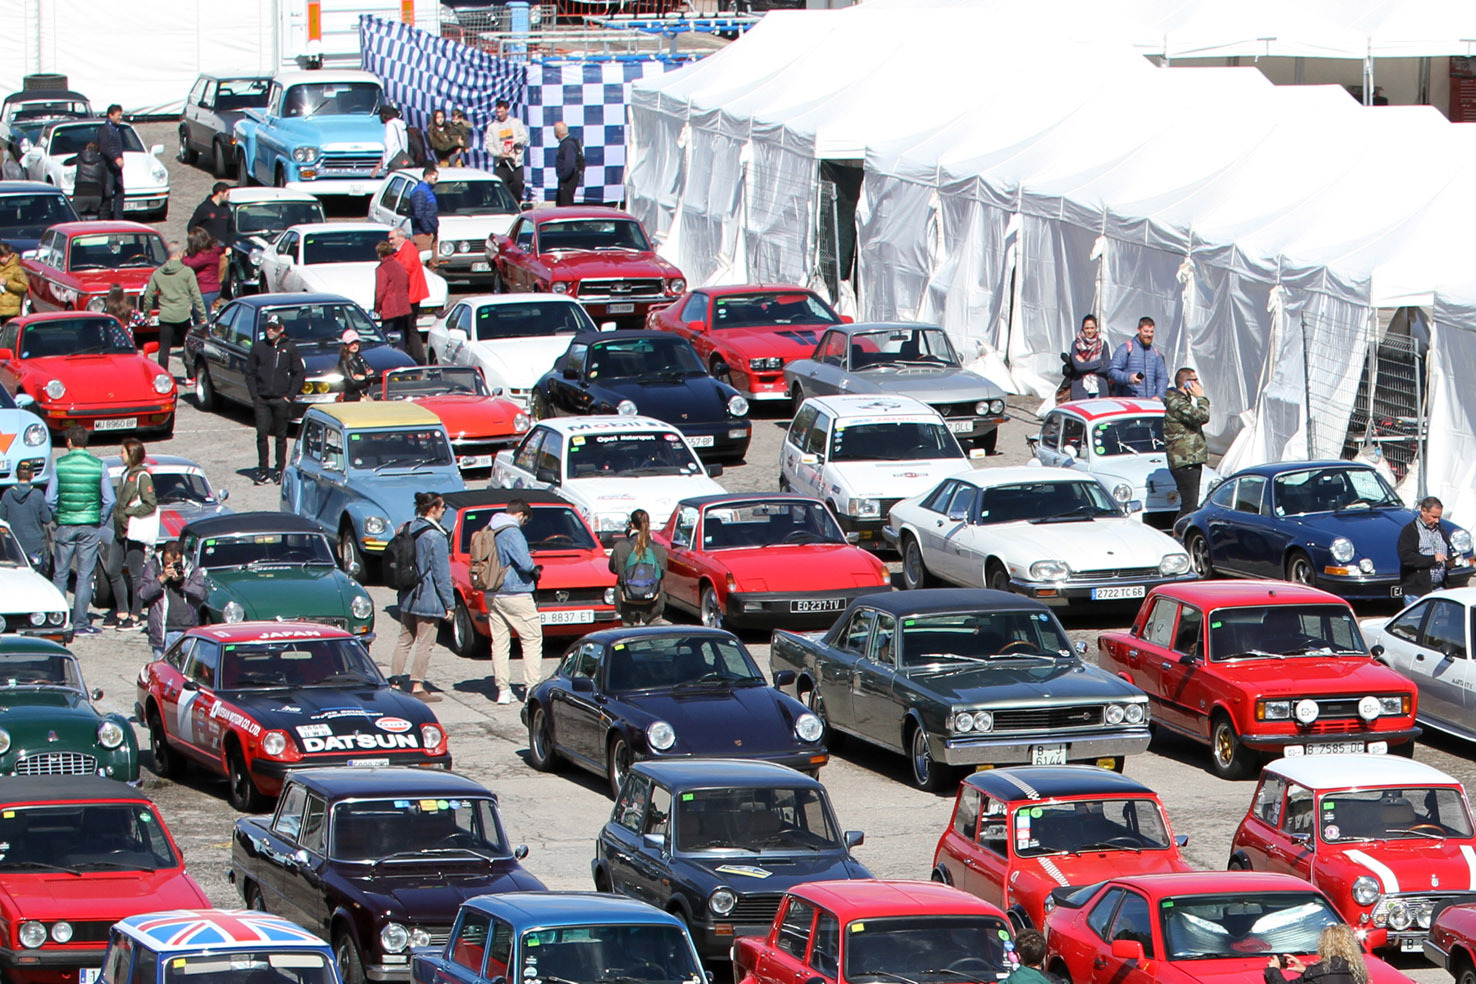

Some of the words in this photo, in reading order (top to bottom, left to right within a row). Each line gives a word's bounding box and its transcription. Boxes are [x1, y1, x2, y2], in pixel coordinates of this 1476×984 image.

[596, 435, 618, 443] Opel
[1097, 589, 1119, 598] 2722
[1121, 588, 1131, 597] TC
[1132, 587, 1143, 596] 66
[551, 612, 575, 623] 8837
[260, 631, 321, 639] JAPAN
[303, 733, 420, 752] DATSUN
[1319, 743, 1345, 754] 7585
[1350, 742, 1364, 753] DC
[1035, 756, 1062, 766] 6144
[1406, 938, 1414, 950] B
